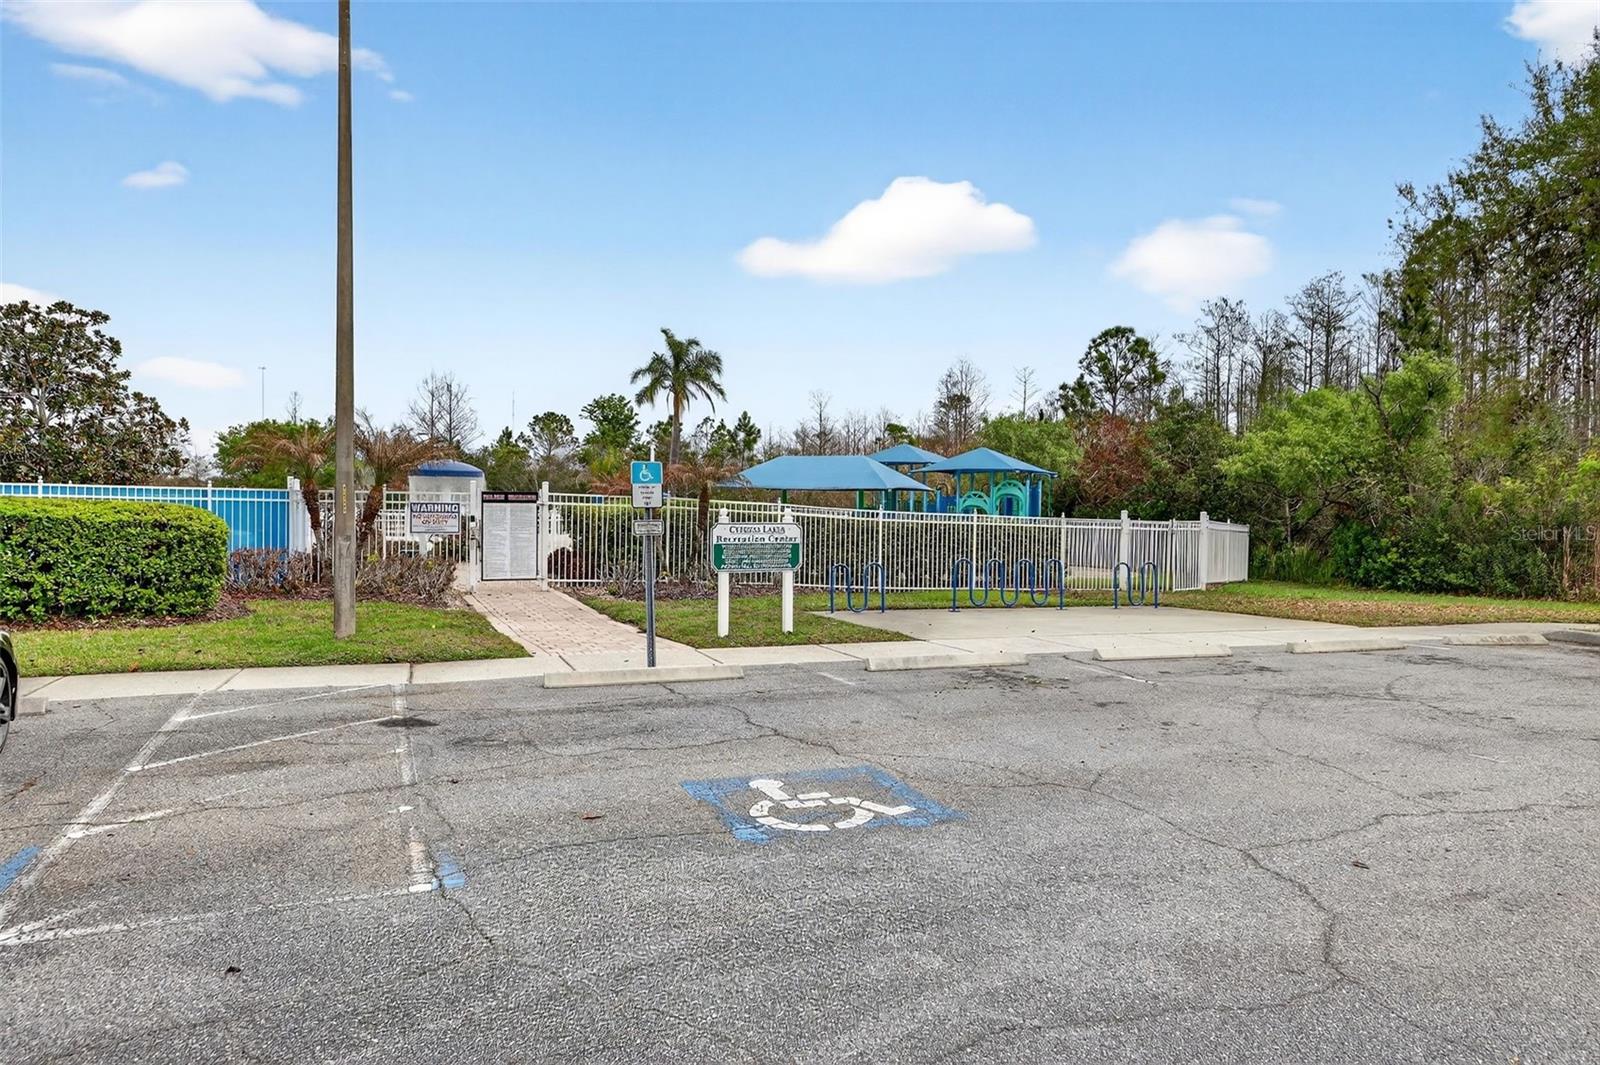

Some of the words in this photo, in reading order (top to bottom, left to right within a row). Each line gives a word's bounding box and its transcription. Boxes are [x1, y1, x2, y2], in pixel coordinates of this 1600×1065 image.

[411, 503, 459, 512] WARNING
[716, 535, 765, 543] Recreation
[768, 534, 798, 543] Center
